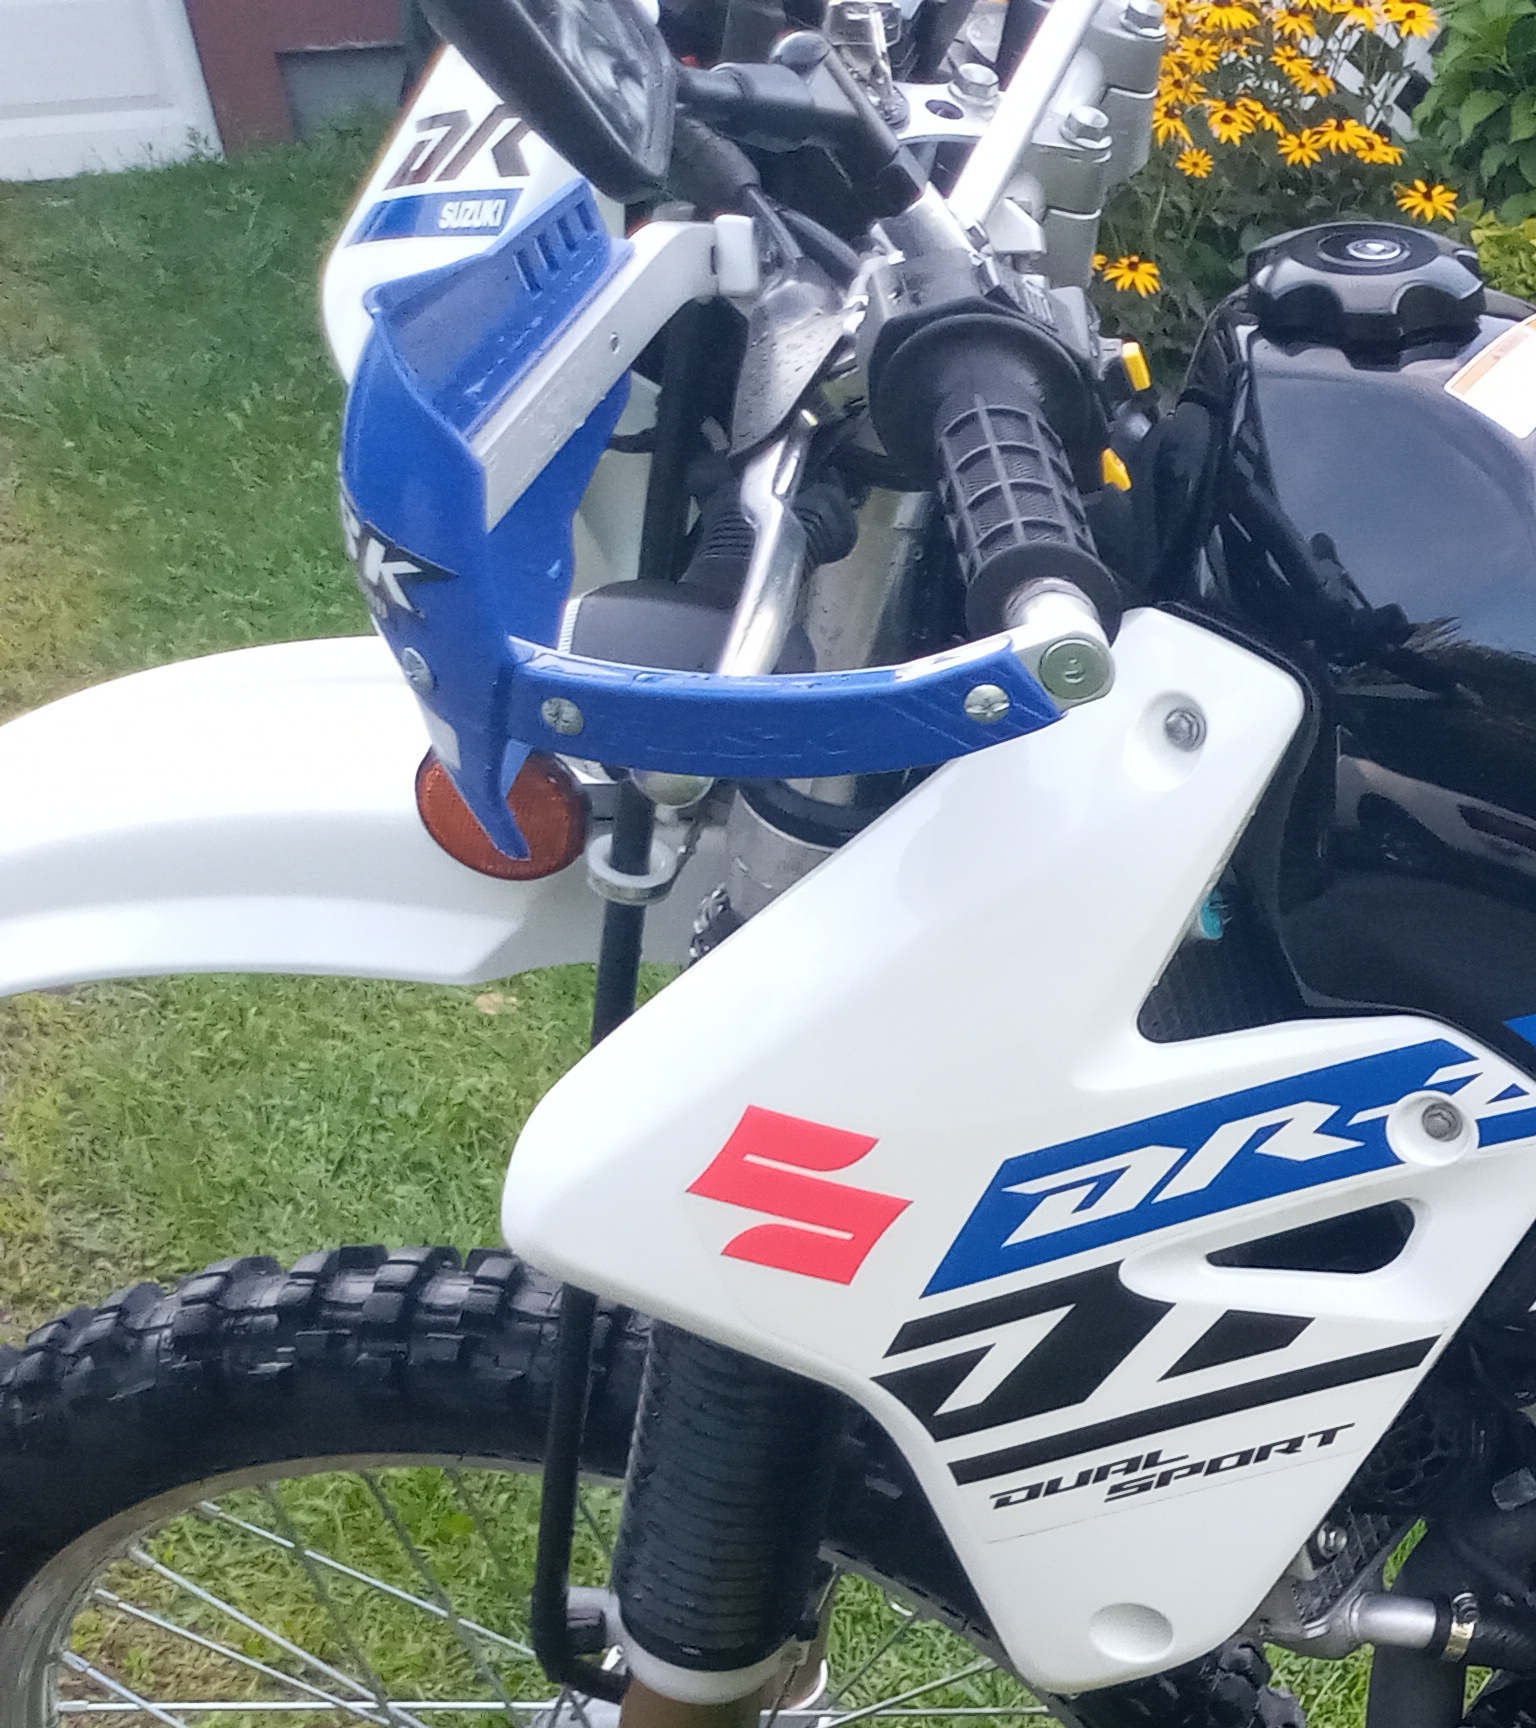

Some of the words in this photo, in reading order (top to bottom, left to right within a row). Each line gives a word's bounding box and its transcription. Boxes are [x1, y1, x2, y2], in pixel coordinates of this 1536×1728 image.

[438, 199, 507, 230] SUZUKI
[989, 1448, 1190, 1510] DUAL
[1103, 1421, 1356, 1504] SPORT
